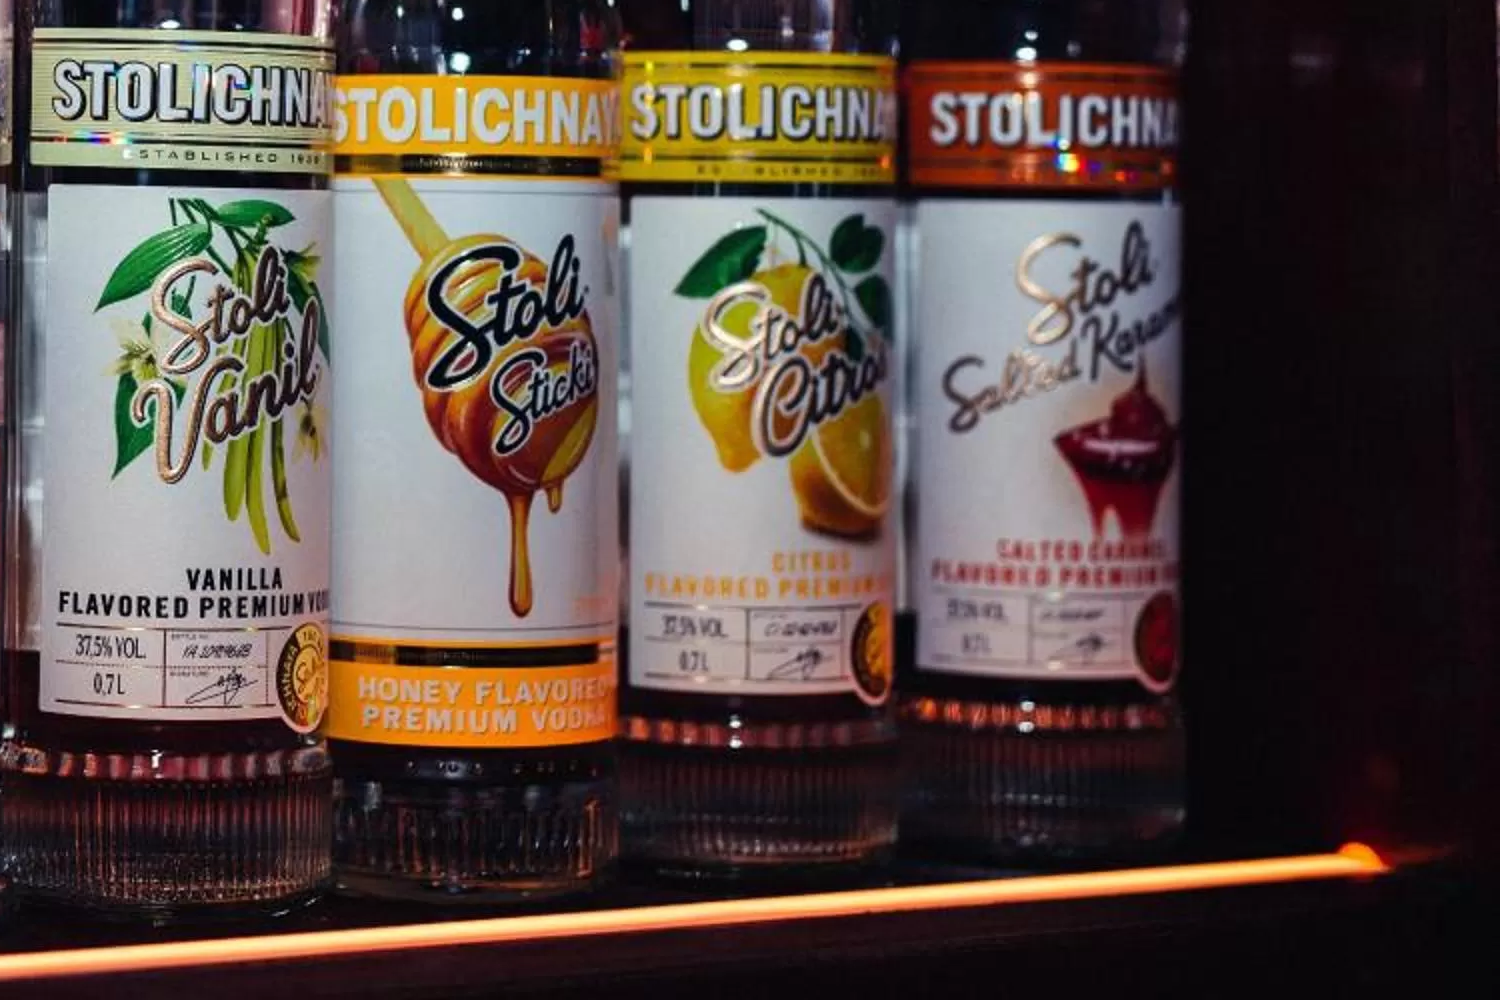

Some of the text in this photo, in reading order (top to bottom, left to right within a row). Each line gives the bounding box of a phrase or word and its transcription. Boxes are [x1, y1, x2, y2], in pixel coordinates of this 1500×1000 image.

[152, 245, 291, 375] Stoli
[427, 233, 585, 388] Stoli
[1017, 220, 1156, 345] Stoli
[706, 273, 841, 388] Stoli
[132, 296, 320, 485] Vanil
[491, 339, 595, 453] Sticki
[58, 590, 190, 619] FLAVORED
[199, 592, 305, 619] PREMIUM
[186, 567, 283, 591] VANILLA
[644, 571, 770, 600] FLAVORED
[115, 636, 147, 660] VOL.
[358, 675, 463, 705] HONEY
[362, 704, 518, 734] PREMIUM
